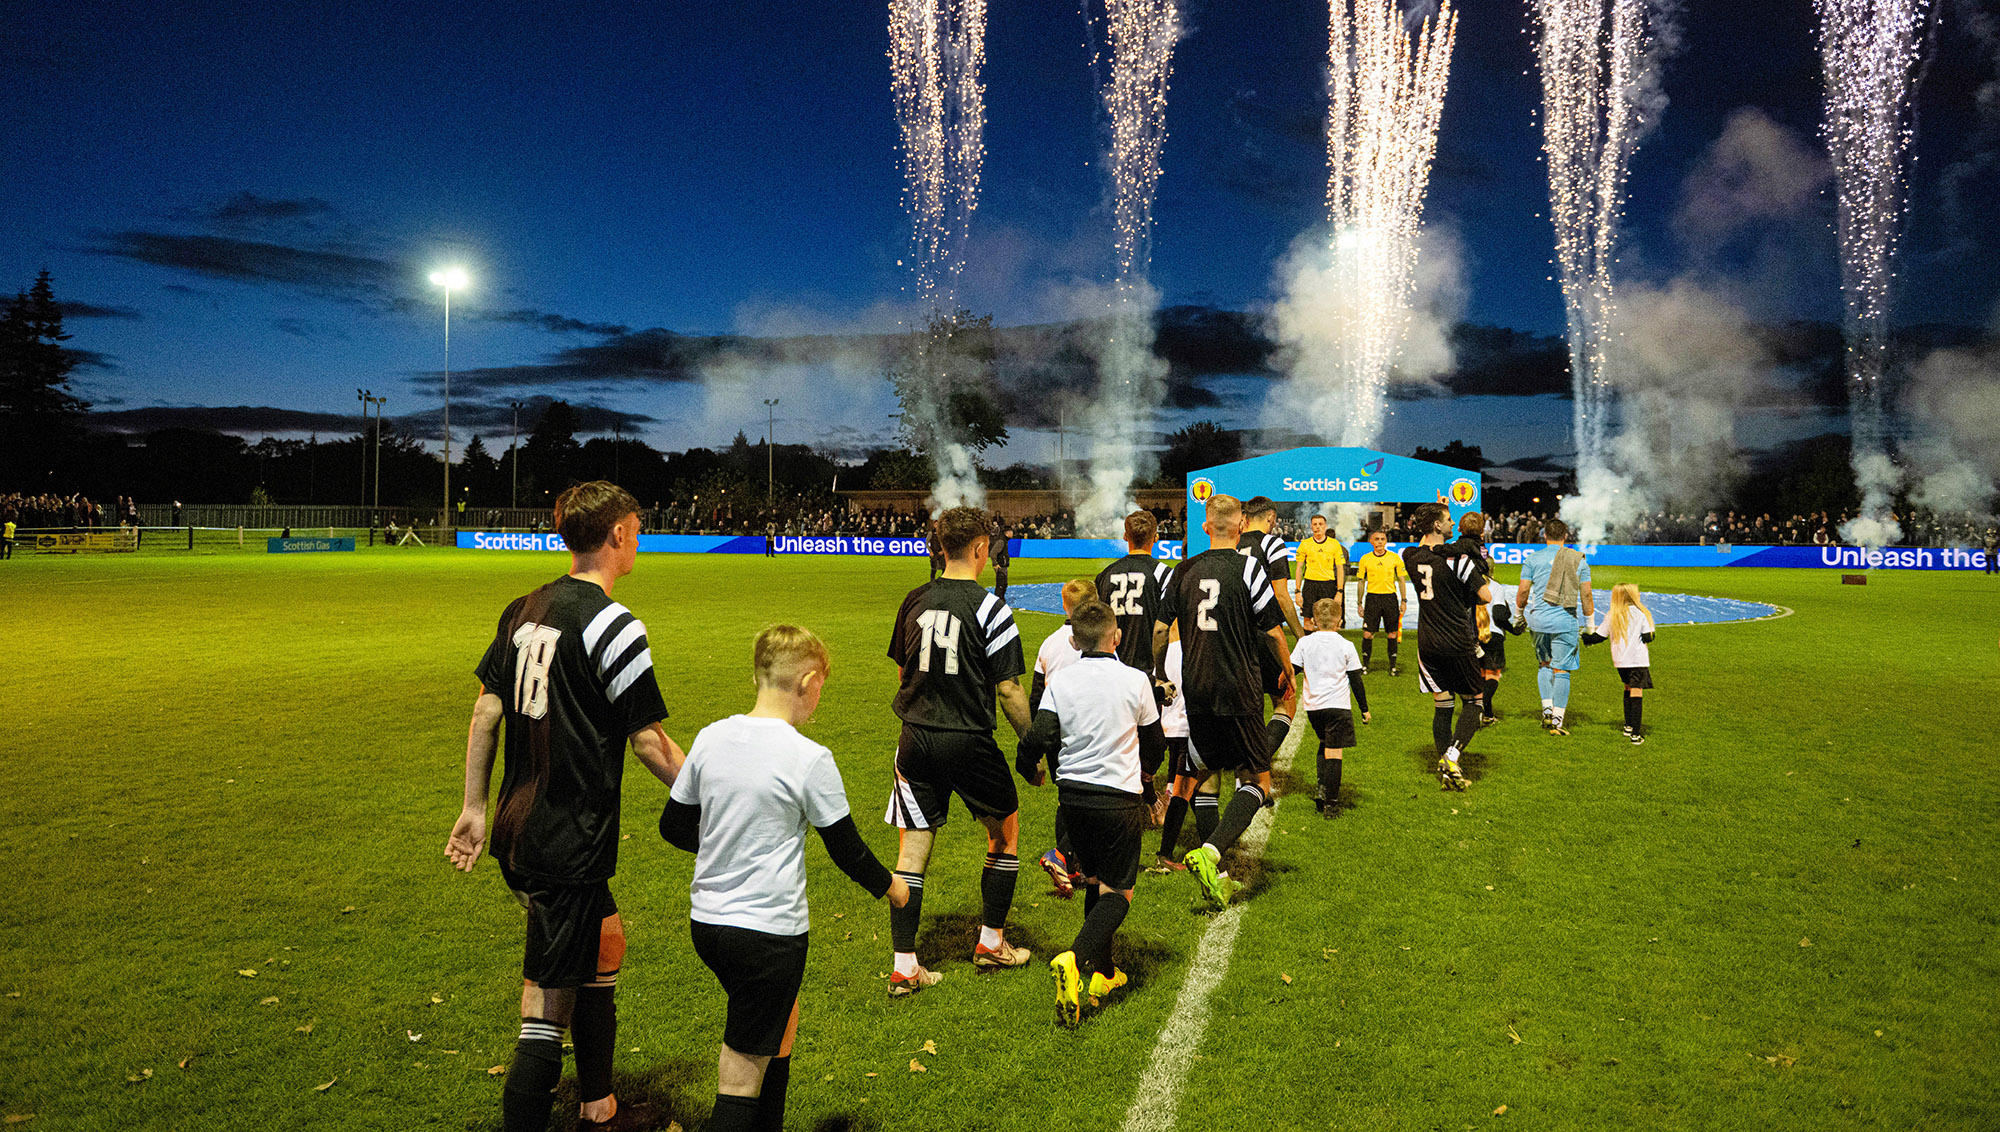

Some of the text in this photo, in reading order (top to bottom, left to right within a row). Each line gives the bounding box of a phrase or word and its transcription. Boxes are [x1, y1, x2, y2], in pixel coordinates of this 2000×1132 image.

[1283, 477, 1378, 491] Scottish Gas
[283, 541, 330, 551] Scottish Gas
[474, 531, 569, 551] Scottish Ga
[773, 535, 848, 552] Unleash
[852, 537, 885, 553] the
[1822, 546, 1987, 568] Unleash the
[1110, 572, 1146, 615] 22
[1417, 564, 1434, 600] 3
[1197, 578, 1221, 631] 2
[916, 609, 961, 675] 14
[512, 621, 562, 720] 18
